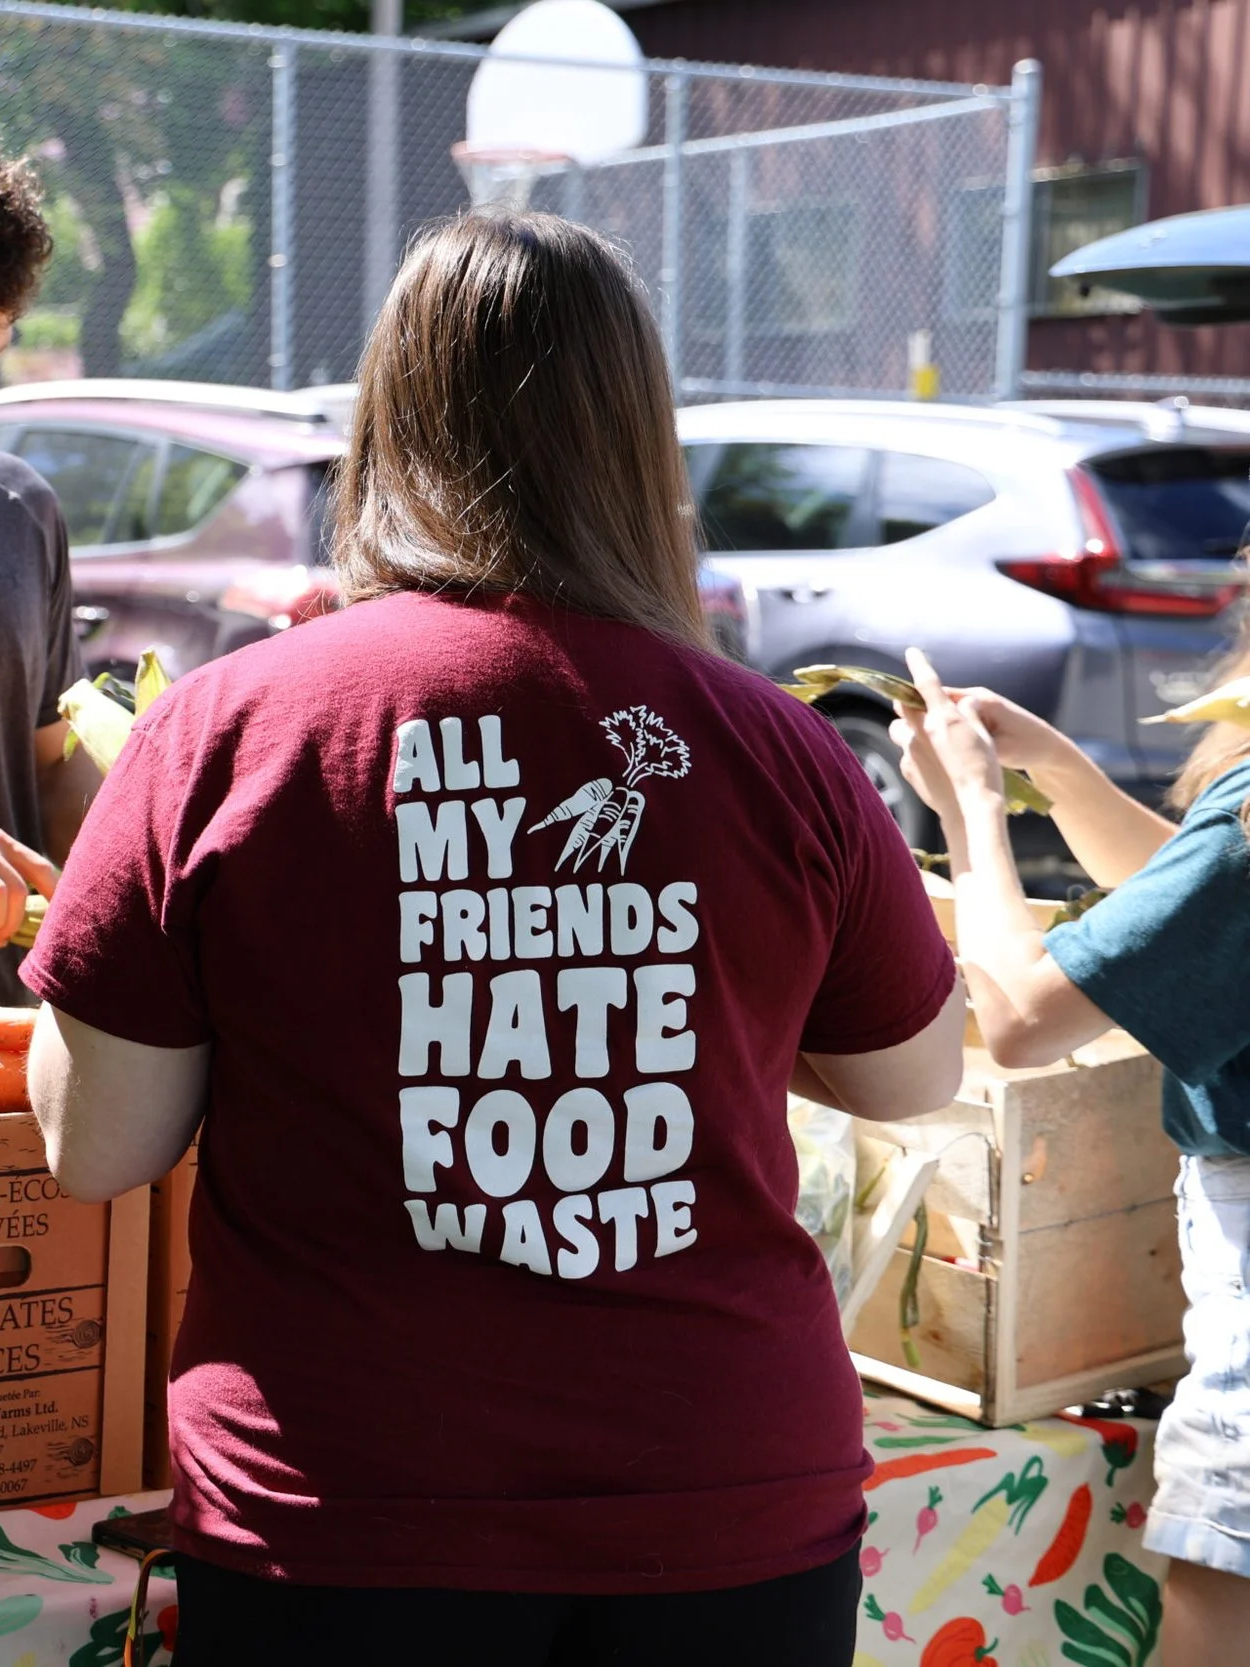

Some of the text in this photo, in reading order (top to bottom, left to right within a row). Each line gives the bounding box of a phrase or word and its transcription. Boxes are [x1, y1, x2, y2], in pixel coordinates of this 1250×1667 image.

[393, 715, 520, 792] ALL
[395, 797, 526, 882] MY
[398, 881, 699, 963] FRIENDS
[398, 964, 696, 1079] HATE
[399, 1082, 694, 1197] FOOD
[403, 1181, 698, 1279] WASTE
[12, 1417, 68, 1437] Lakeville,
[71, 1415, 90, 1430] NS
[35, 1401, 59, 1415] Ltd.
